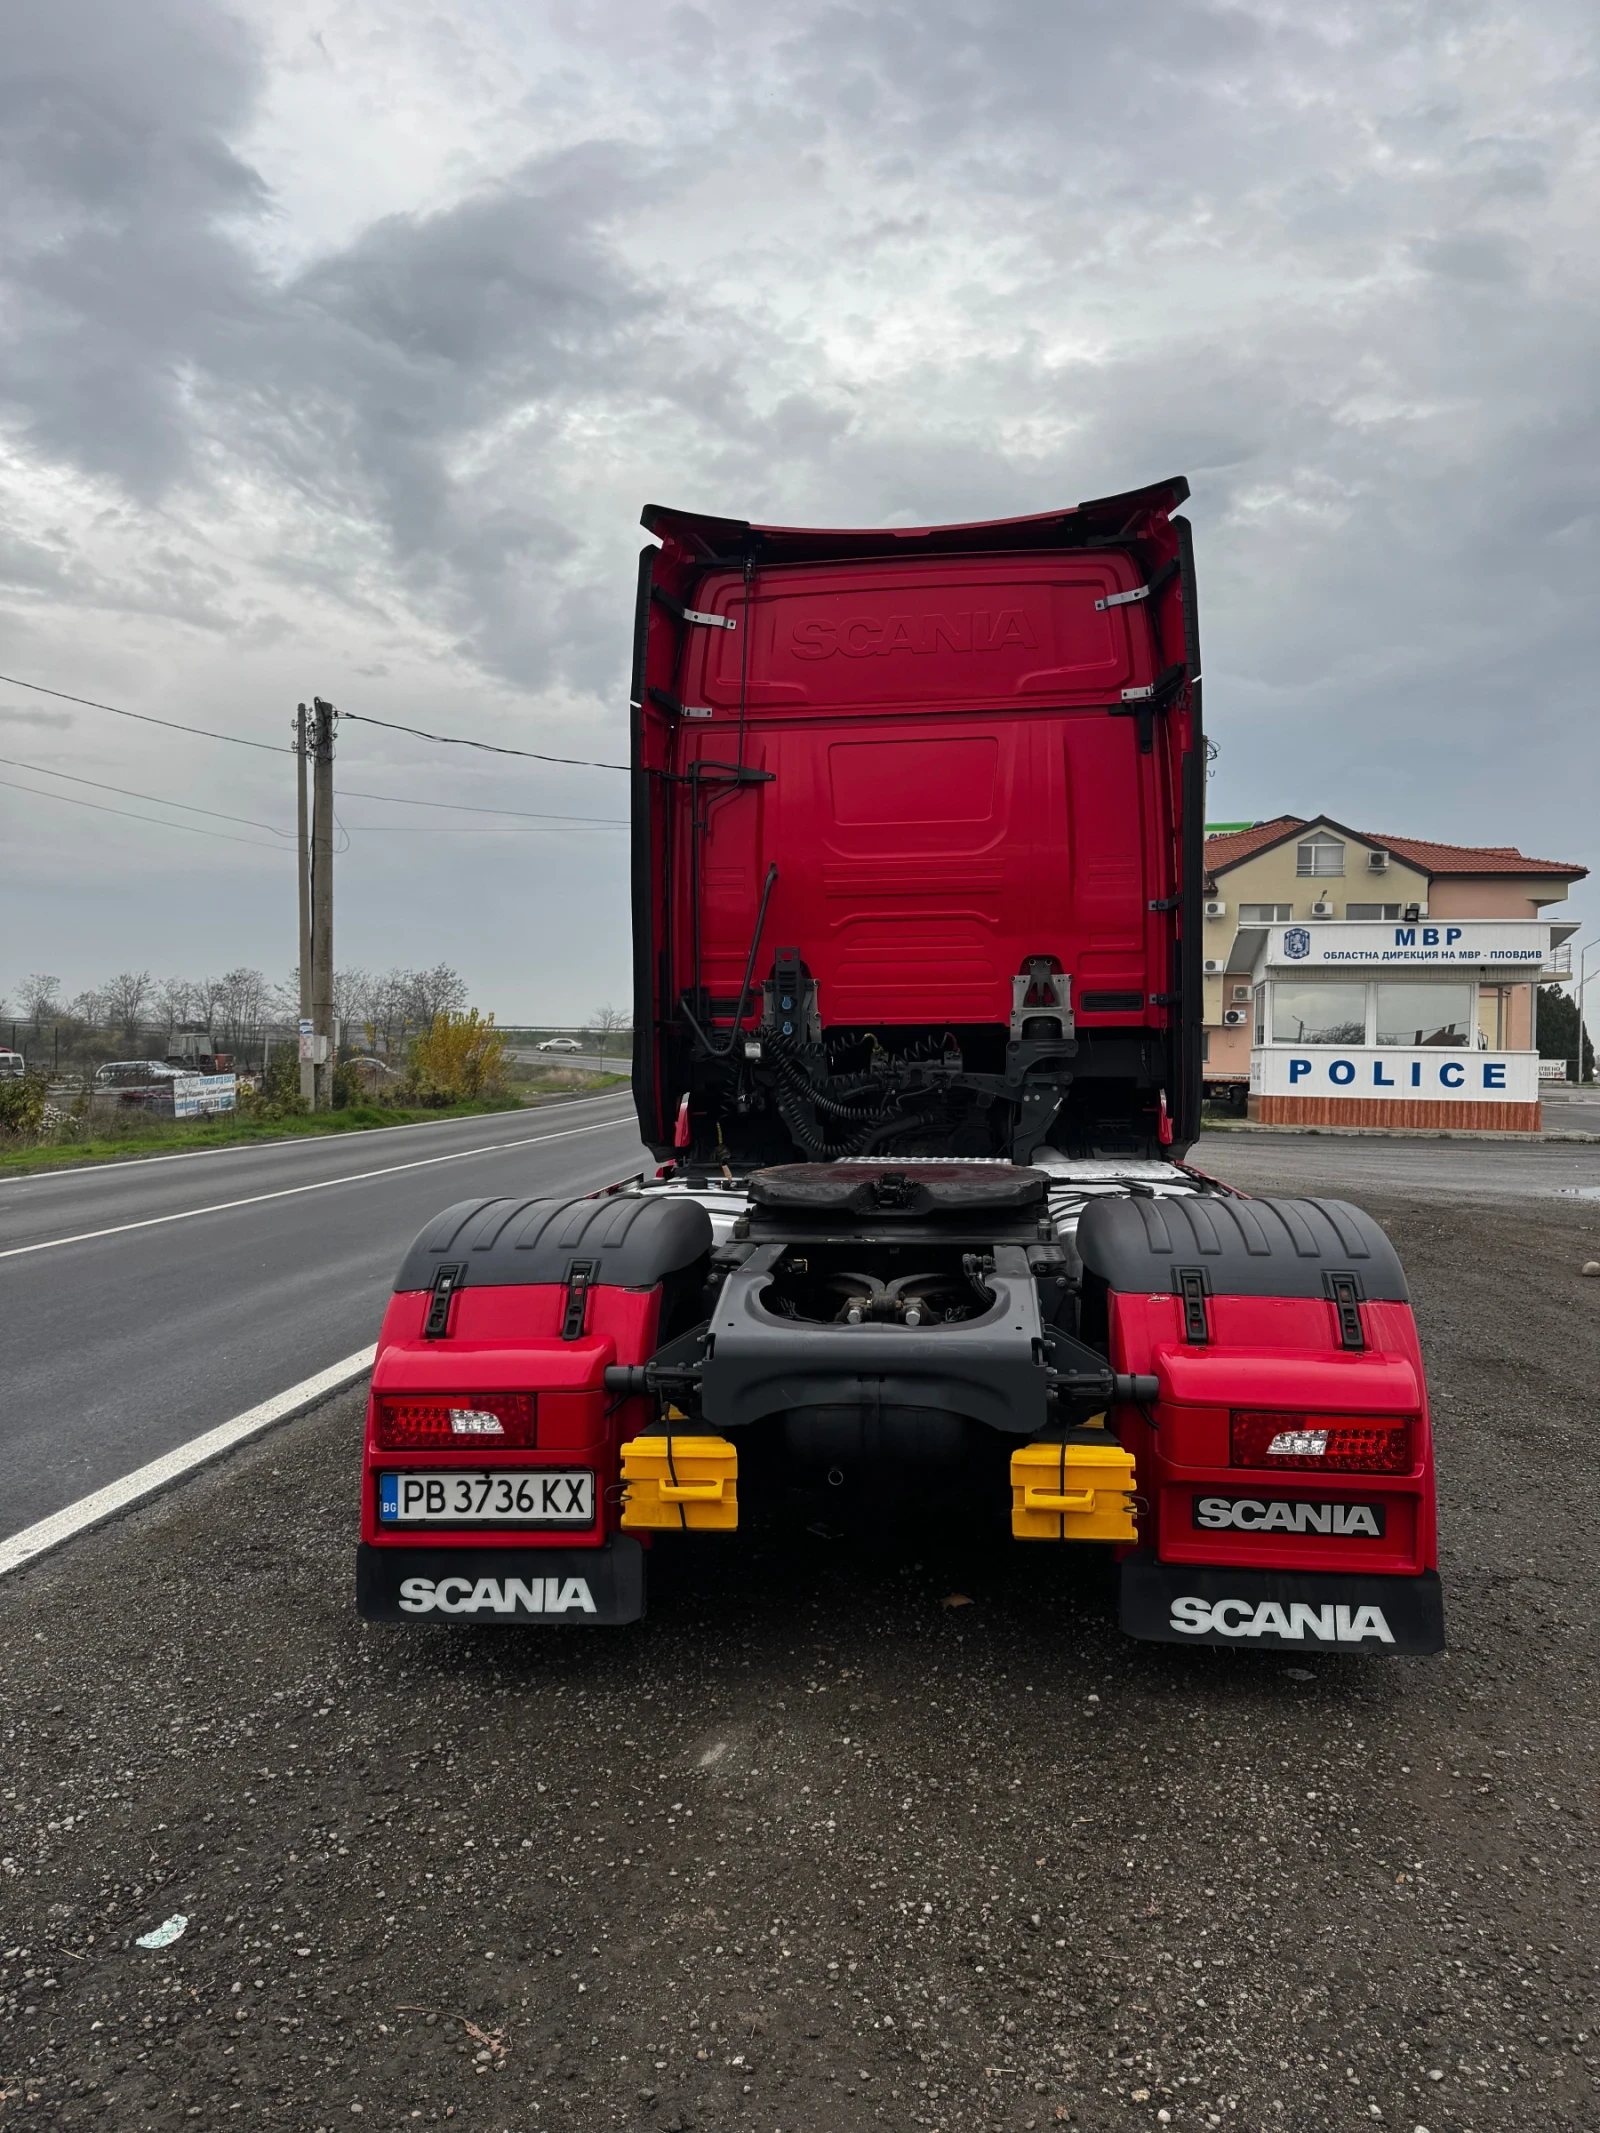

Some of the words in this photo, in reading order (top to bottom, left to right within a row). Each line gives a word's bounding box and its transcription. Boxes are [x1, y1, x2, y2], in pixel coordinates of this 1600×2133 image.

[791, 610, 1039, 660] SCANIA
[1395, 927, 1462, 946] МВР
[1323, 951, 1380, 960] ОБЛАСТНА
[1381, 950, 1439, 961] ДИРЕКЦИЯ
[1441, 950, 1456, 959] НА
[1458, 950, 1481, 959] МВР
[1490, 949, 1542, 960] ПЛОВДИВ
[1289, 1059, 1506, 1089] POLICE
[382, 1502, 397, 1513] BG
[404, 1480, 446, 1514] PB
[454, 1479, 534, 1513] 3736
[542, 1478, 585, 1513] KX
[1197, 1498, 1380, 1536] SCANIA
[398, 1577, 598, 1614] SCANIA
[1169, 1596, 1396, 1643] SCANIA
